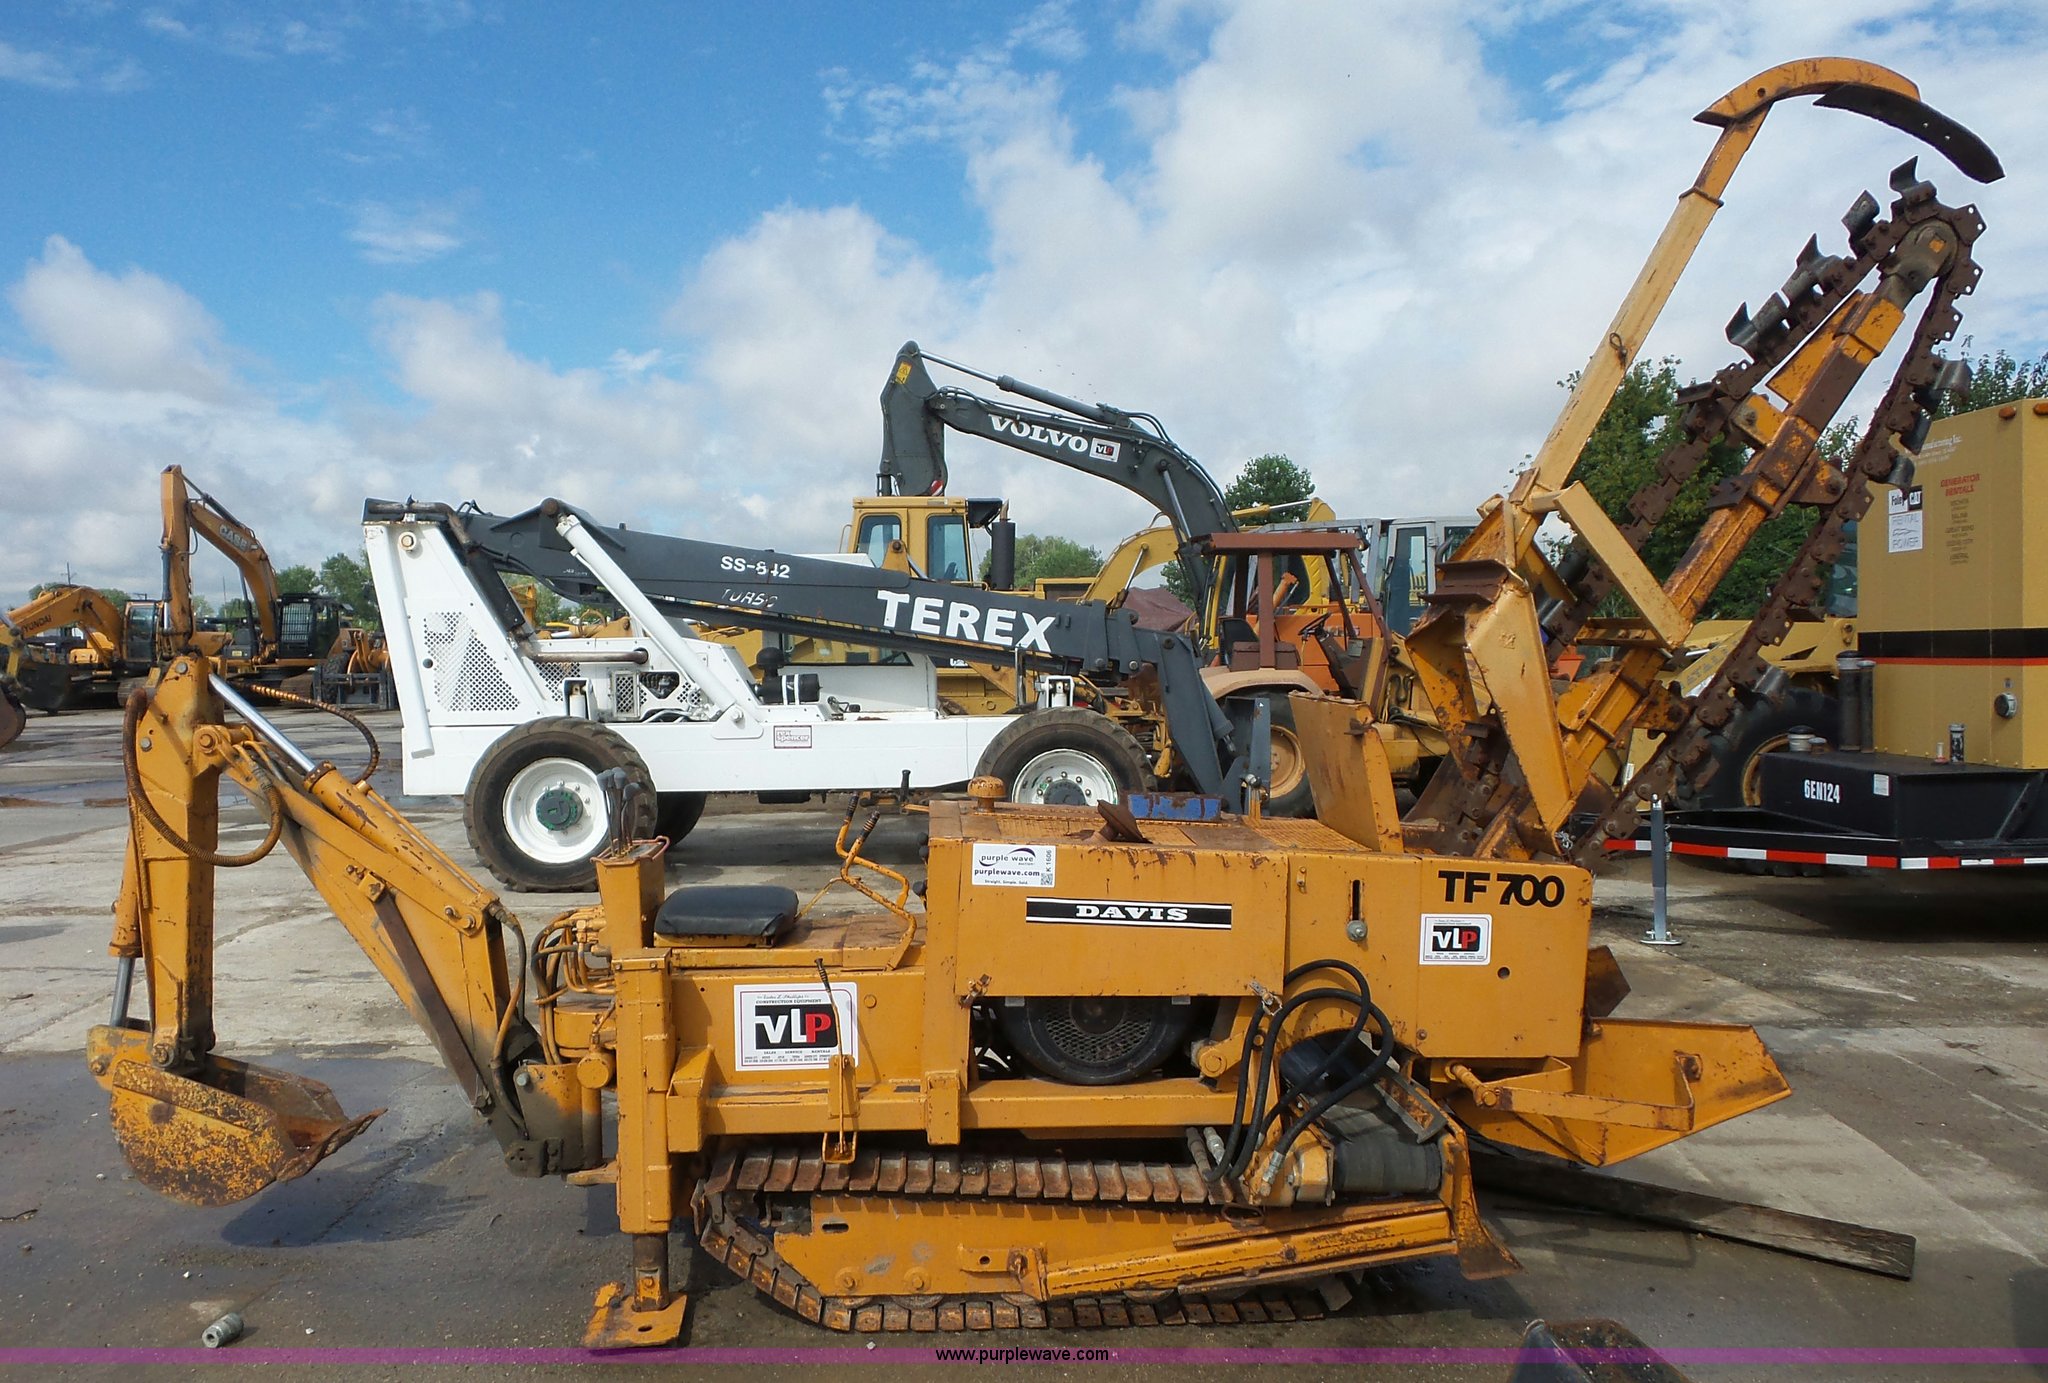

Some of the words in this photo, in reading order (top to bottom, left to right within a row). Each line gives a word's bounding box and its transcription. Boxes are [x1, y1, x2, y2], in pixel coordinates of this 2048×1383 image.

[988, 414, 1089, 453] VOLVO
[720, 556, 790, 578] SS-842
[876, 589, 1056, 653] TEREX
[981, 855, 1009, 863] purple
[974, 868, 1040, 877] purplewave.com
[1438, 870, 1491, 903] TF
[1496, 872, 1565, 908] 700
[1075, 905, 1188, 921] DAVIS
[1432, 927, 1478, 950] VLP
[755, 1008, 831, 1044] VLP
